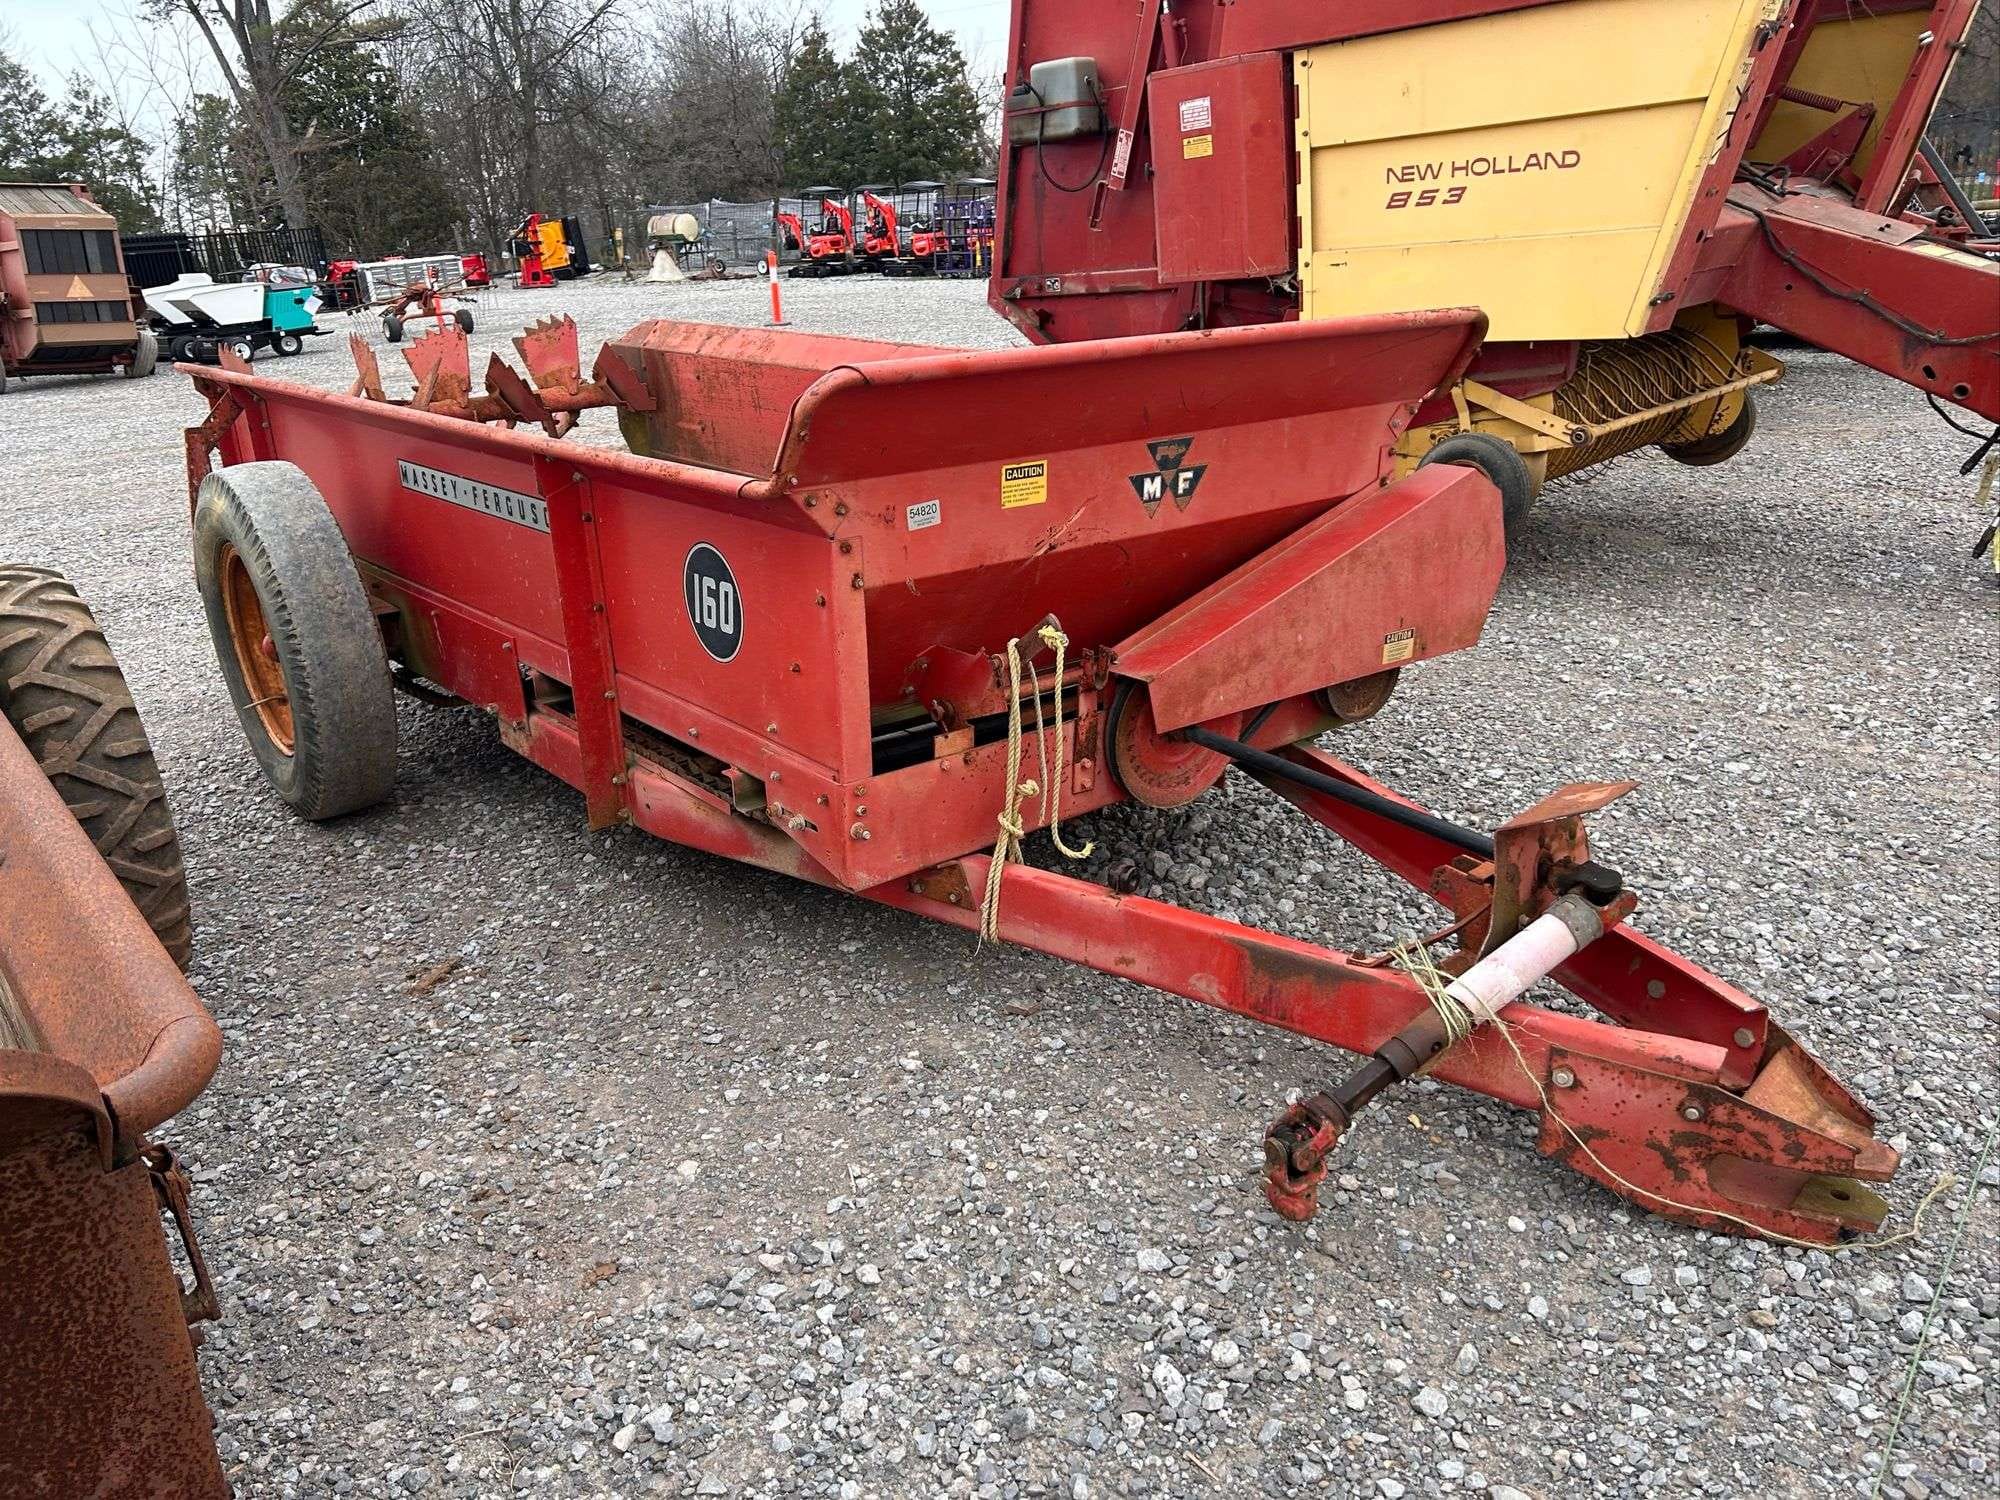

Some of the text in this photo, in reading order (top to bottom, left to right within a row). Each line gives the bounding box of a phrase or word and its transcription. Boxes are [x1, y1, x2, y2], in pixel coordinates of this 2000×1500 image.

[1386, 150, 1581, 184] NEW HOLLAND
[1385, 186, 1467, 210] 853
[1006, 466, 1043, 480] CAUTION
[909, 503, 937, 519] 54820
[693, 573, 734, 635] 160
